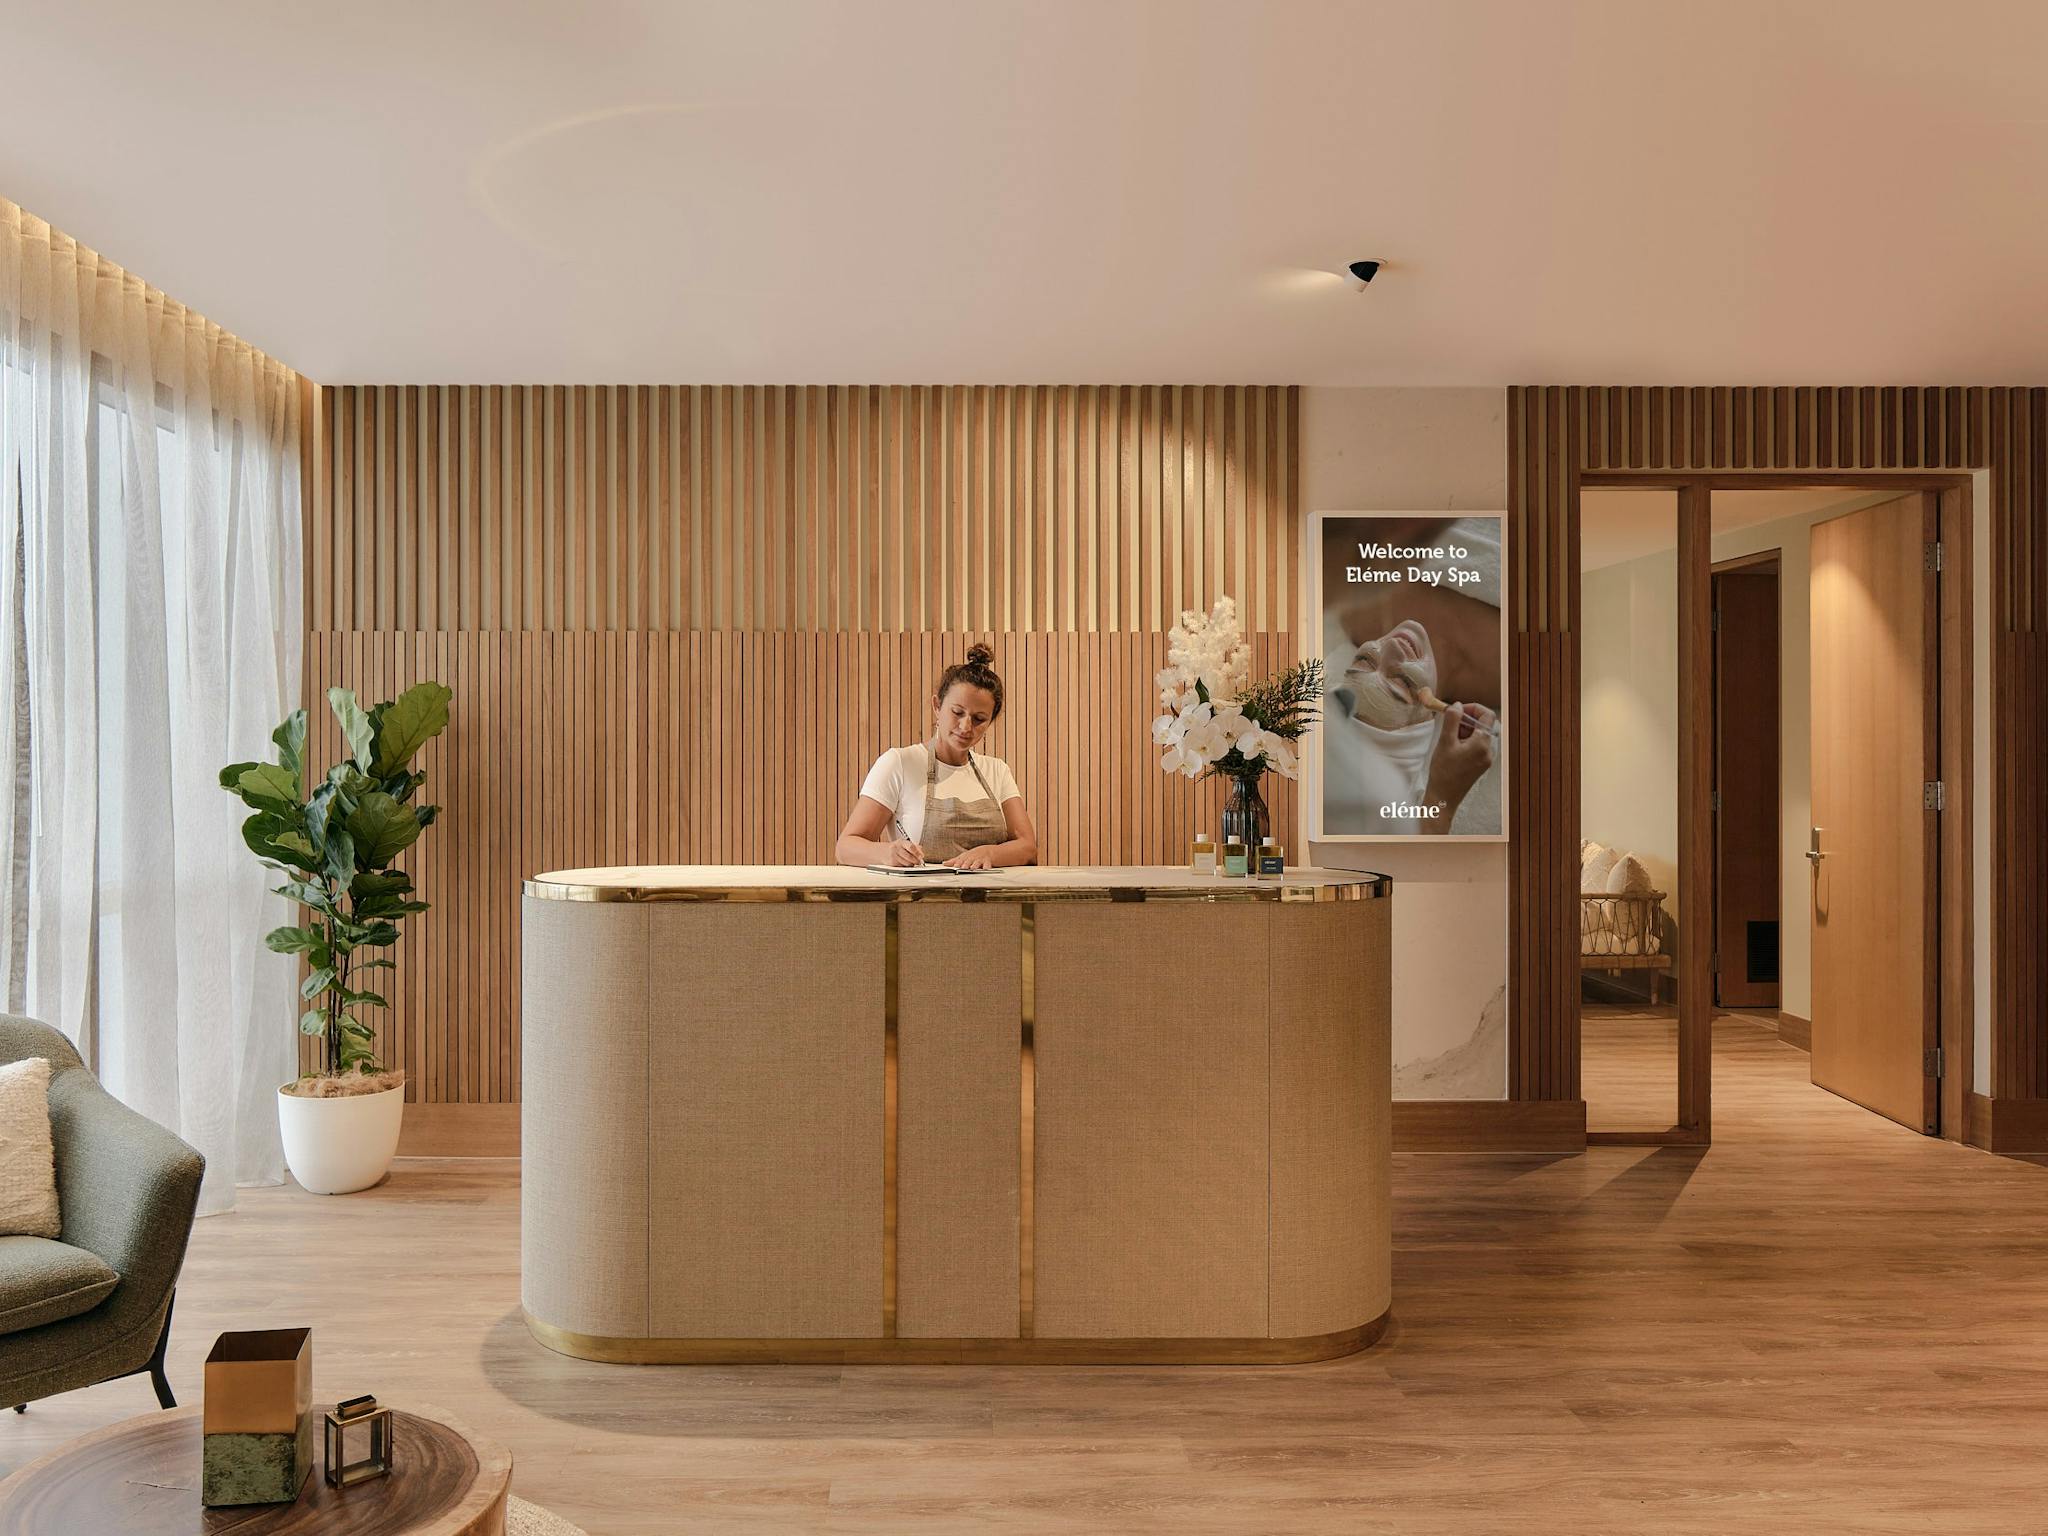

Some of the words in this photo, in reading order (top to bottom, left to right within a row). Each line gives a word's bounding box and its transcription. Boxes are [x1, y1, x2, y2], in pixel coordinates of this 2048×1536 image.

[1358, 543, 1444, 559] Welcome
[1449, 544, 1468, 559] to
[1346, 566, 1401, 582] Eléme
[1407, 566, 1442, 587] Day
[1447, 566, 1481, 587] Spa
[1379, 801, 1440, 819] eléme
